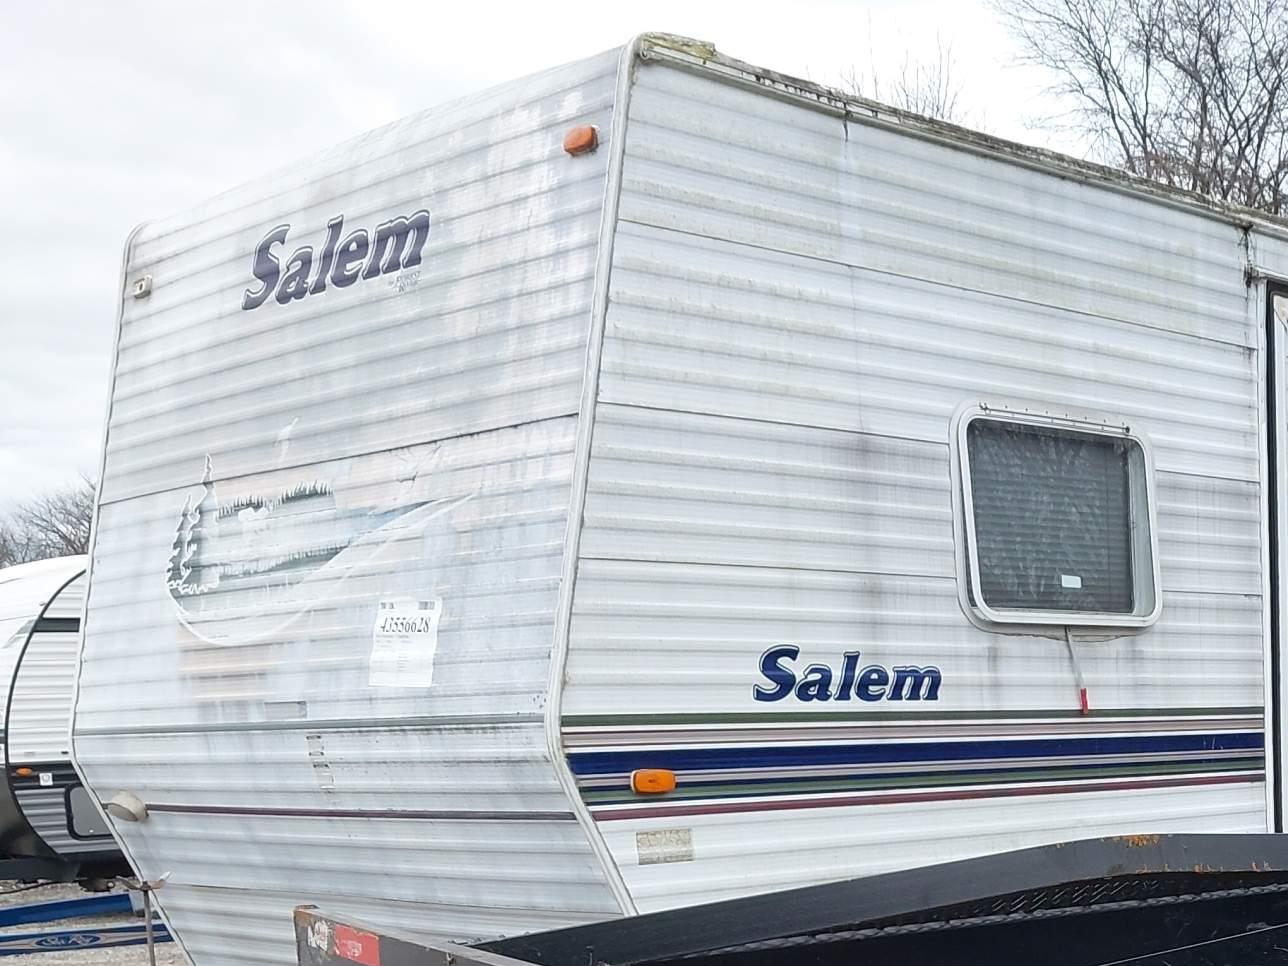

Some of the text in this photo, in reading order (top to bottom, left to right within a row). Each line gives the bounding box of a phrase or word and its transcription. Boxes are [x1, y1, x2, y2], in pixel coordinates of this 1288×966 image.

[242, 209, 431, 310] Salem
[380, 617, 431, 633] 43556628
[752, 644, 942, 702] Salem
